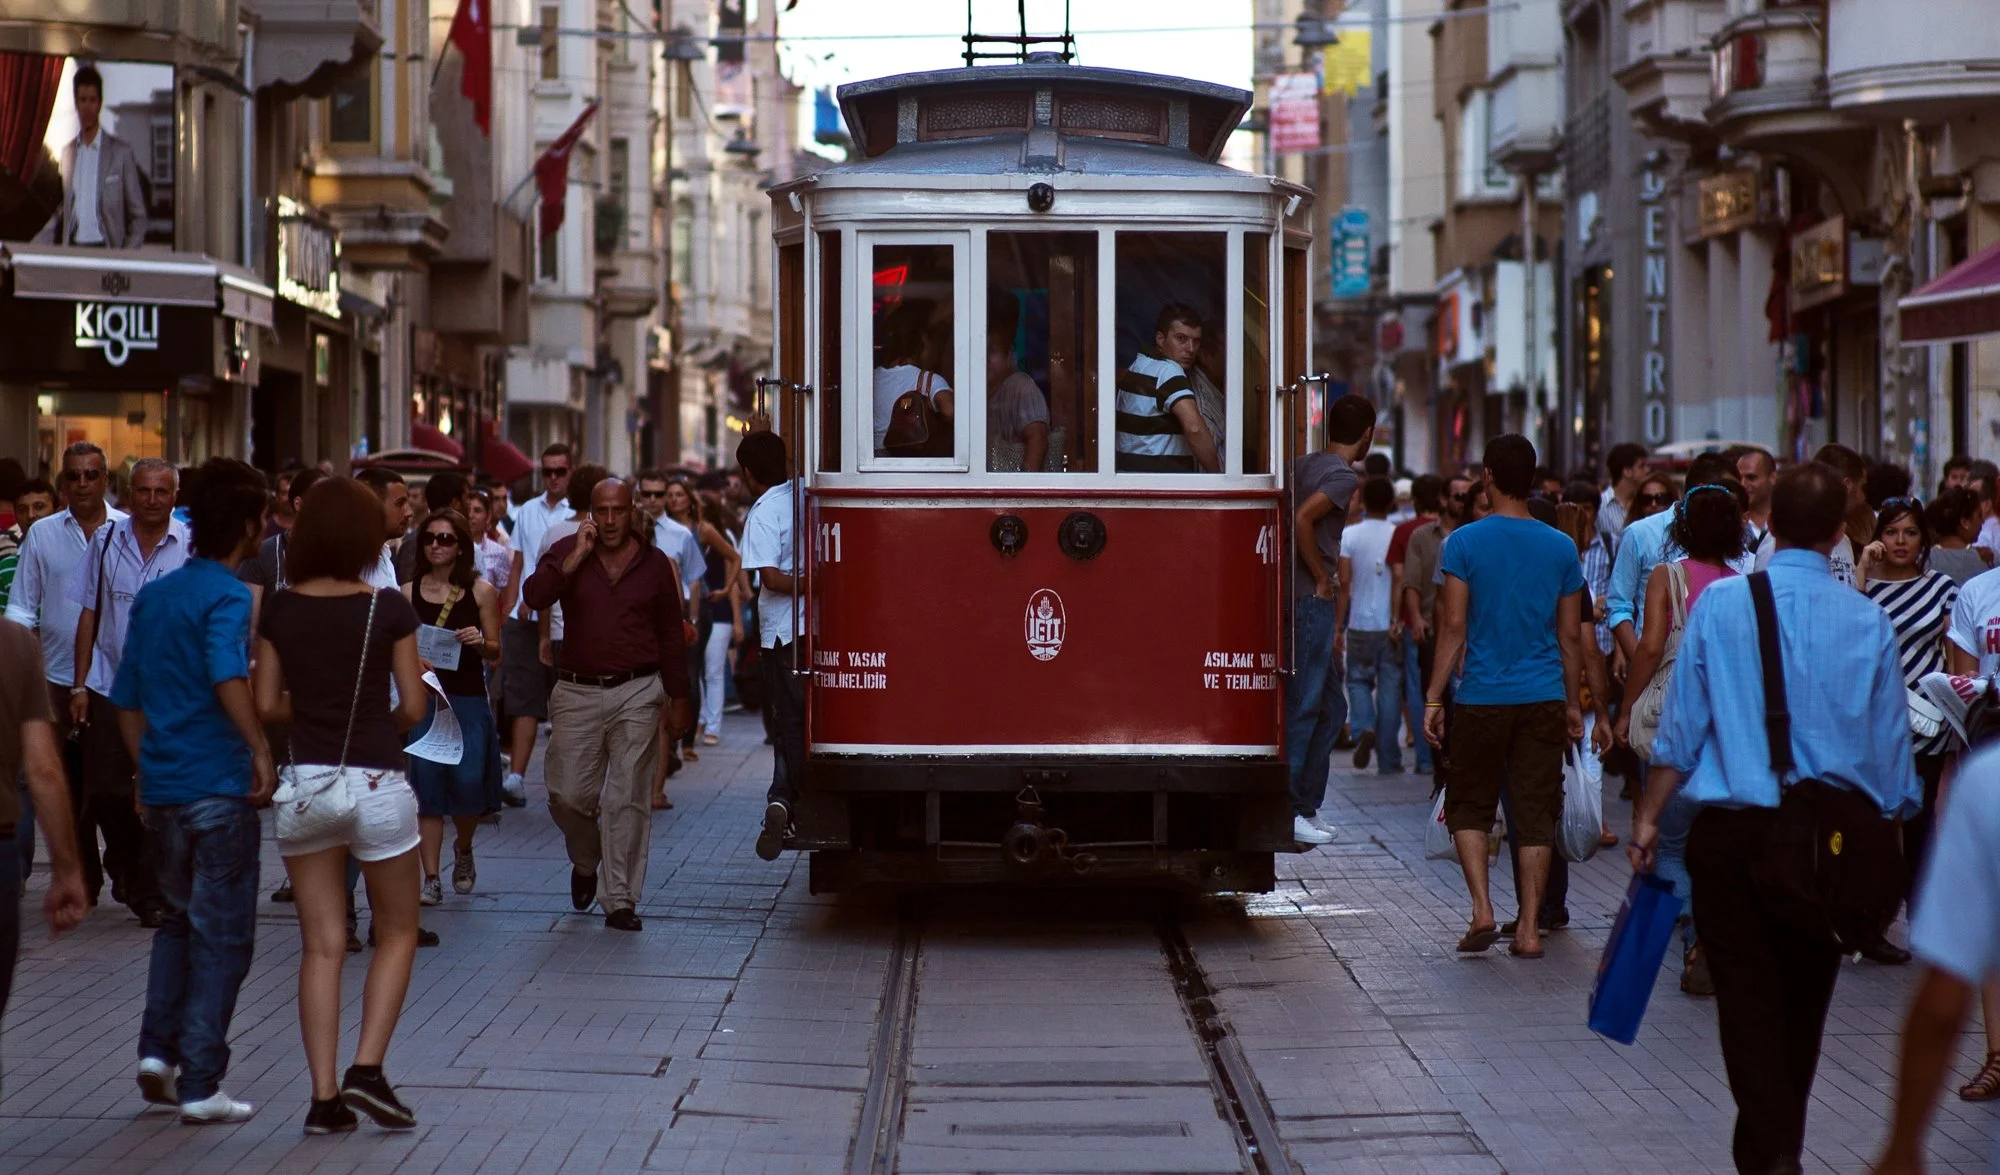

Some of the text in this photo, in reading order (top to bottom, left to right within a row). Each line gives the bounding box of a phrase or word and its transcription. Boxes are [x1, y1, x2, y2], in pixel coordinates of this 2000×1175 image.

[847, 651, 887, 667] YASAK
[1204, 651, 1254, 668] ASILMAK
[1203, 673, 1219, 688] VE
